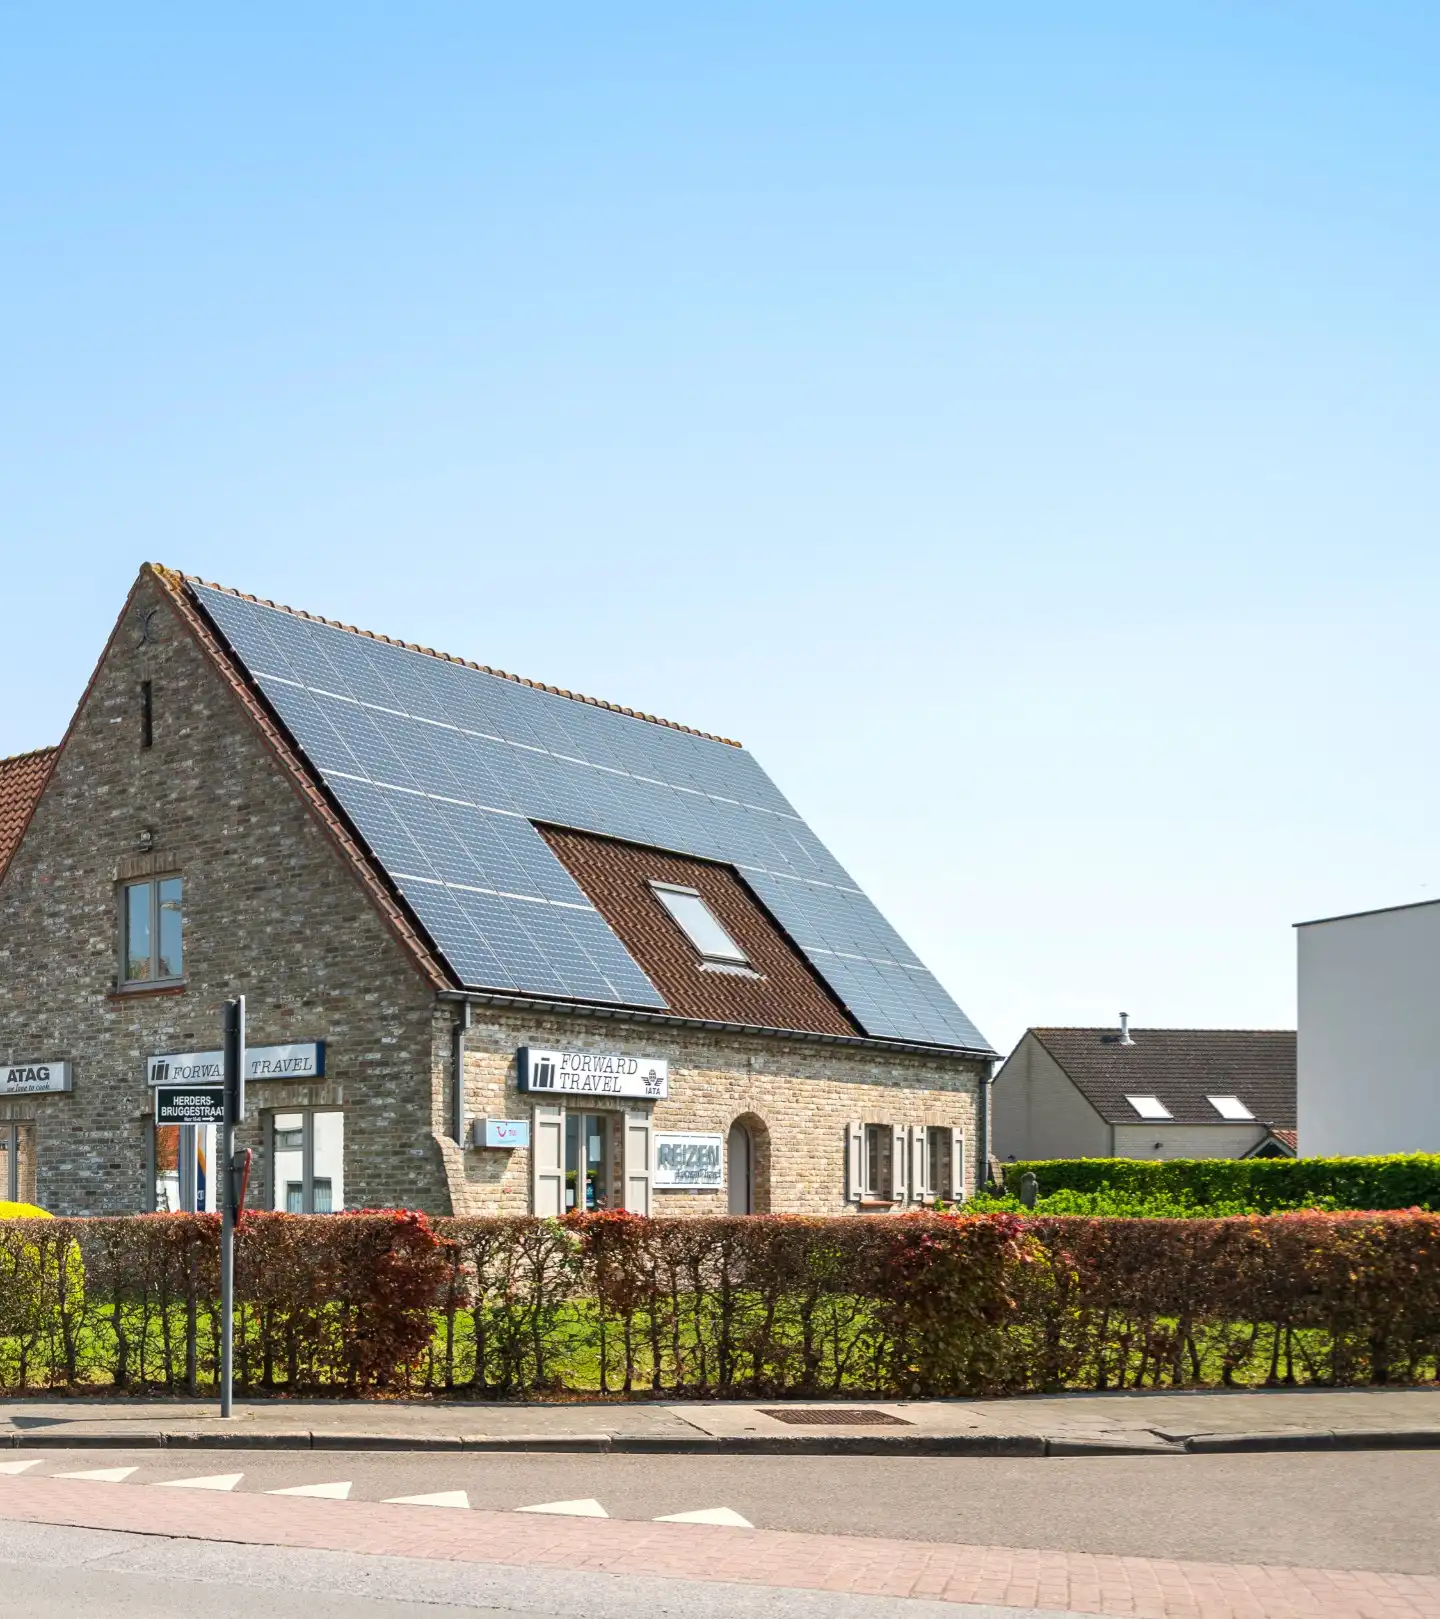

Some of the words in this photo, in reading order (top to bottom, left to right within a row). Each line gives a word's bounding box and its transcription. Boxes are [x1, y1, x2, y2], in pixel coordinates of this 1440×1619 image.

[172, 1063, 224, 1080] FORWA
[251, 1057, 313, 1074] TRAVEL
[560, 1053, 638, 1075] FORWARD
[7, 1066, 50, 1083] ATAG
[560, 1072, 622, 1093] TRAVEL
[35, 1081, 50, 1091] cook
[645, 1087, 661, 1095] IATA
[173, 1095, 215, 1106] HERDERS-
[658, 1144, 720, 1168] REIZEN
